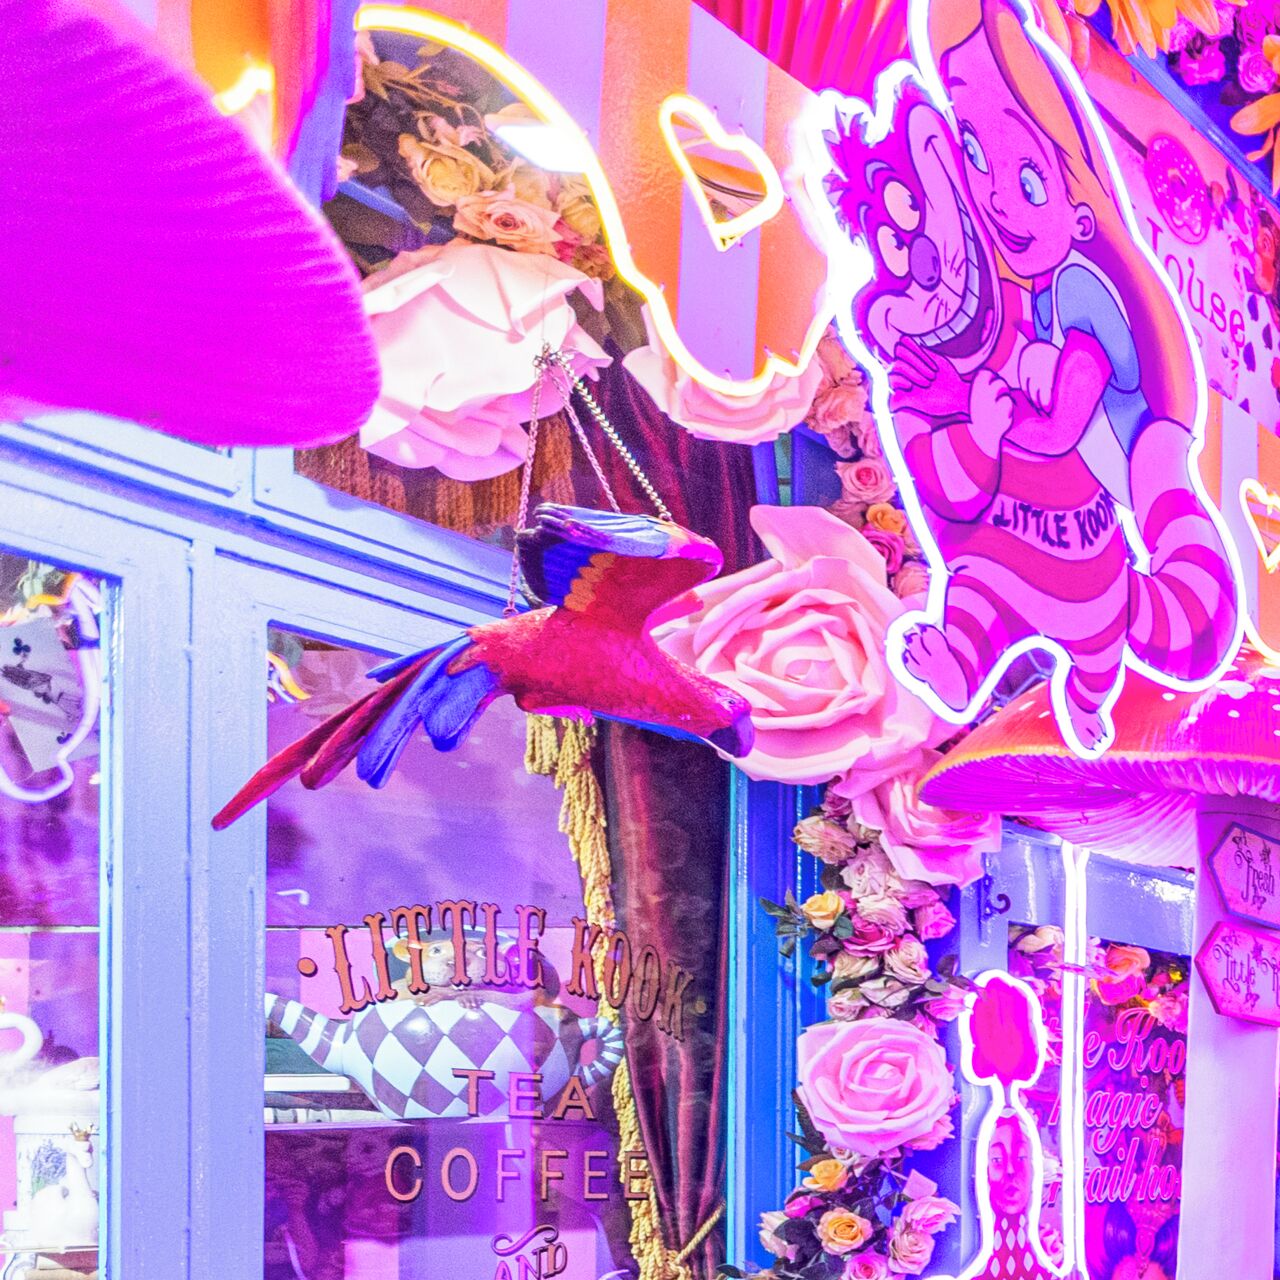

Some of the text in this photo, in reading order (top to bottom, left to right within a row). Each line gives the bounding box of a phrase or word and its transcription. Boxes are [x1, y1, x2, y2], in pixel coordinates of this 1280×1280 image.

[992, 492, 1116, 550] LITTLE KOOK
[324, 899, 694, 1042] LITTLE KOOK
[1107, 1007, 1185, 1074] Koo
[451, 1067, 597, 1120] TEA
[384, 1145, 650, 1202] COFFEE
